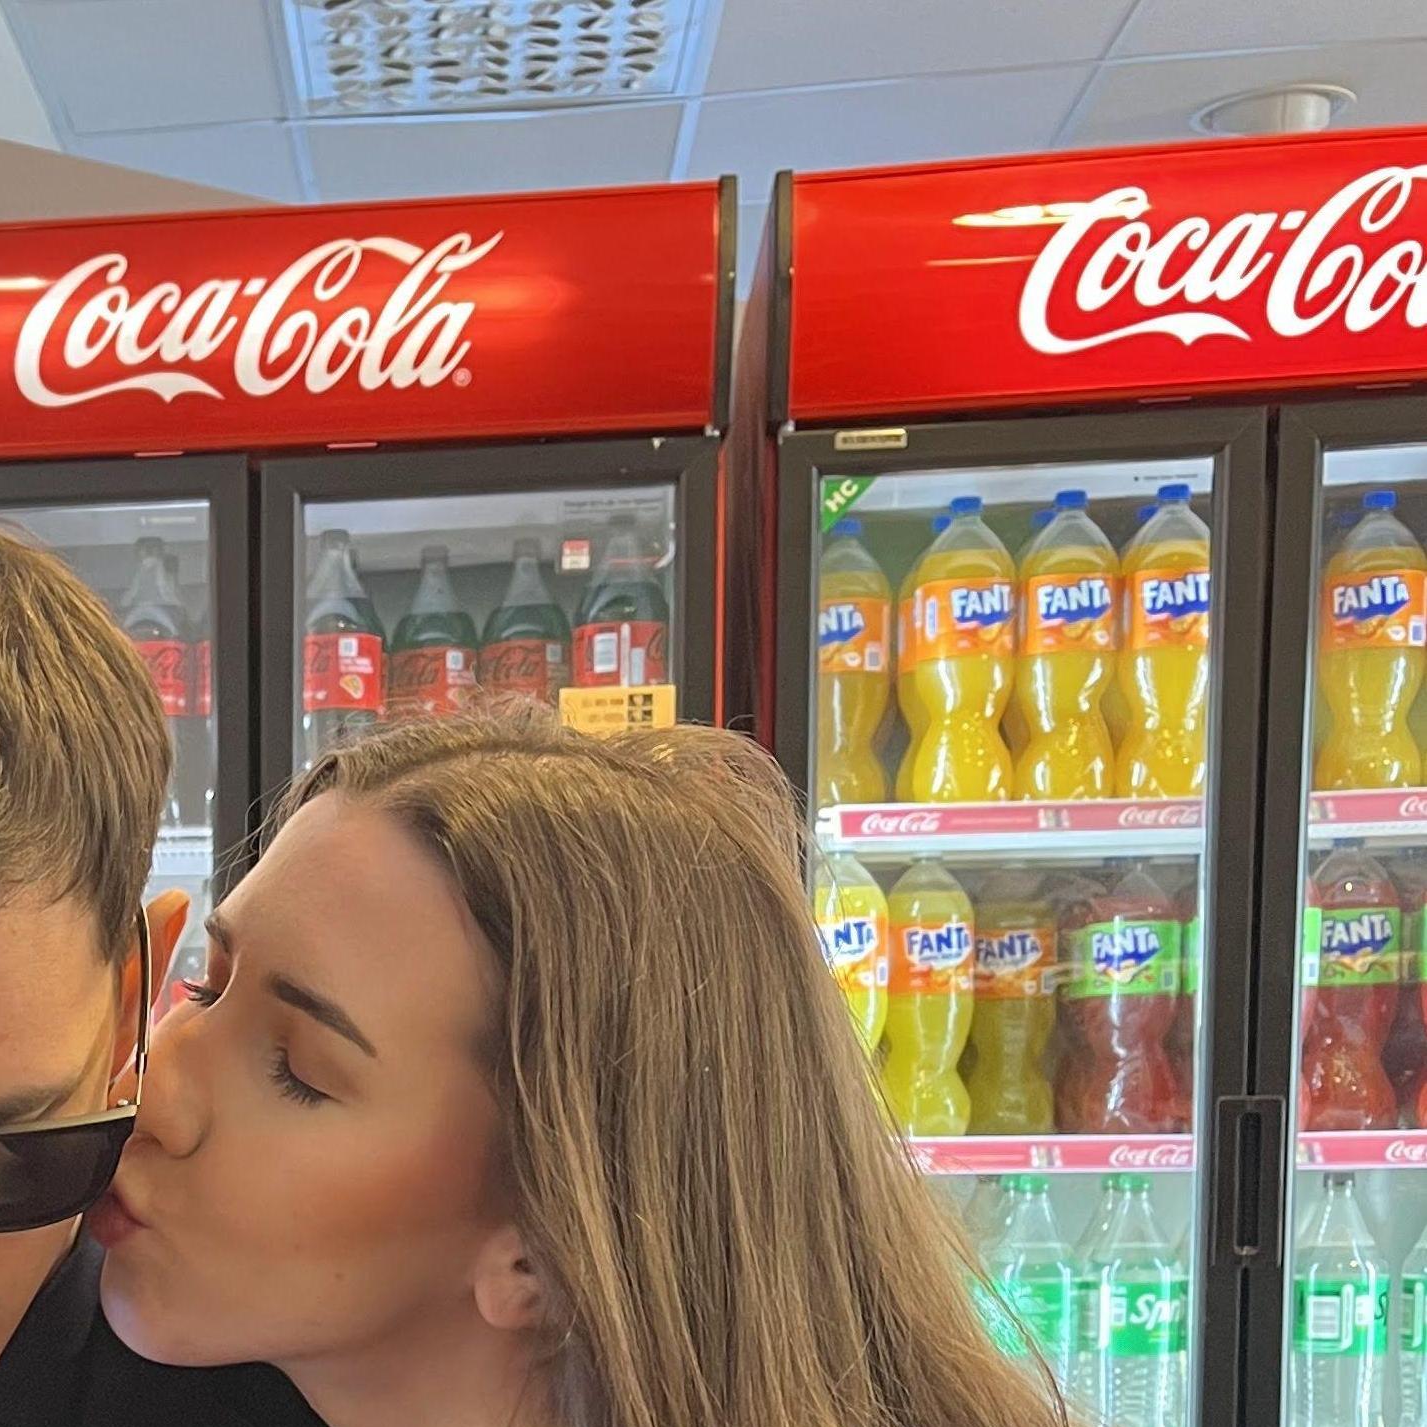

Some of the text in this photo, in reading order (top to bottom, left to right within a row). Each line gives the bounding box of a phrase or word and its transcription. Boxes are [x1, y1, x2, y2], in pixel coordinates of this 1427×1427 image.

[11, 228, 505, 407] Coca-Cola
[825, 479, 859, 513] HC
[951, 584, 1014, 619] FANT
[1037, 579, 1112, 616] FANTA
[1142, 573, 1210, 611] FANT
[1333, 576, 1410, 615] FANTA
[819, 604, 864, 635] NTA
[1091, 926, 1160, 959] FANTA
[1321, 913, 1392, 949] FANTA
